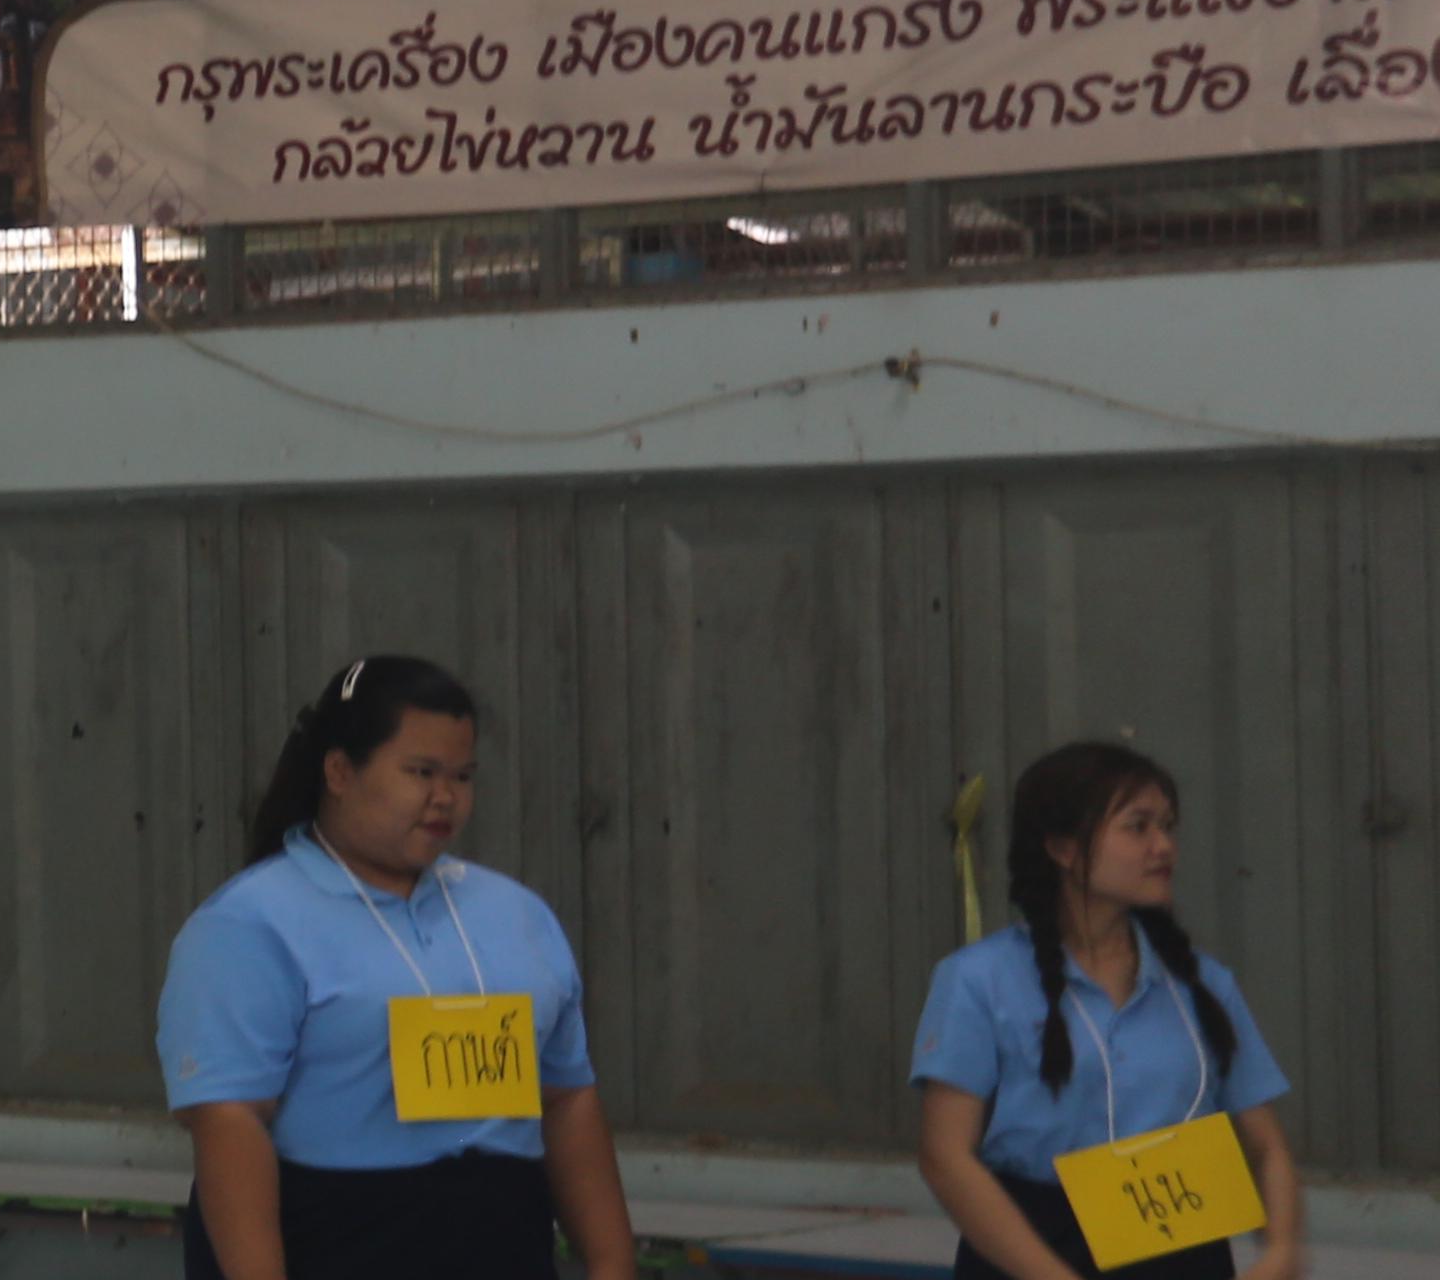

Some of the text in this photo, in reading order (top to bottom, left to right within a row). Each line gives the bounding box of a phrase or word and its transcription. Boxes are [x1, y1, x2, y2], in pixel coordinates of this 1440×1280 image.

[155, 13, 509, 122] กรุพระเครื่อง
[273, 106, 654, 183] กล้วยไข่หวาน
[1286, 10, 1440, 104] เลื่อ
[421, 1009, 521, 1089] กานต์
[1122, 1157, 1204, 1241] นุ่น
